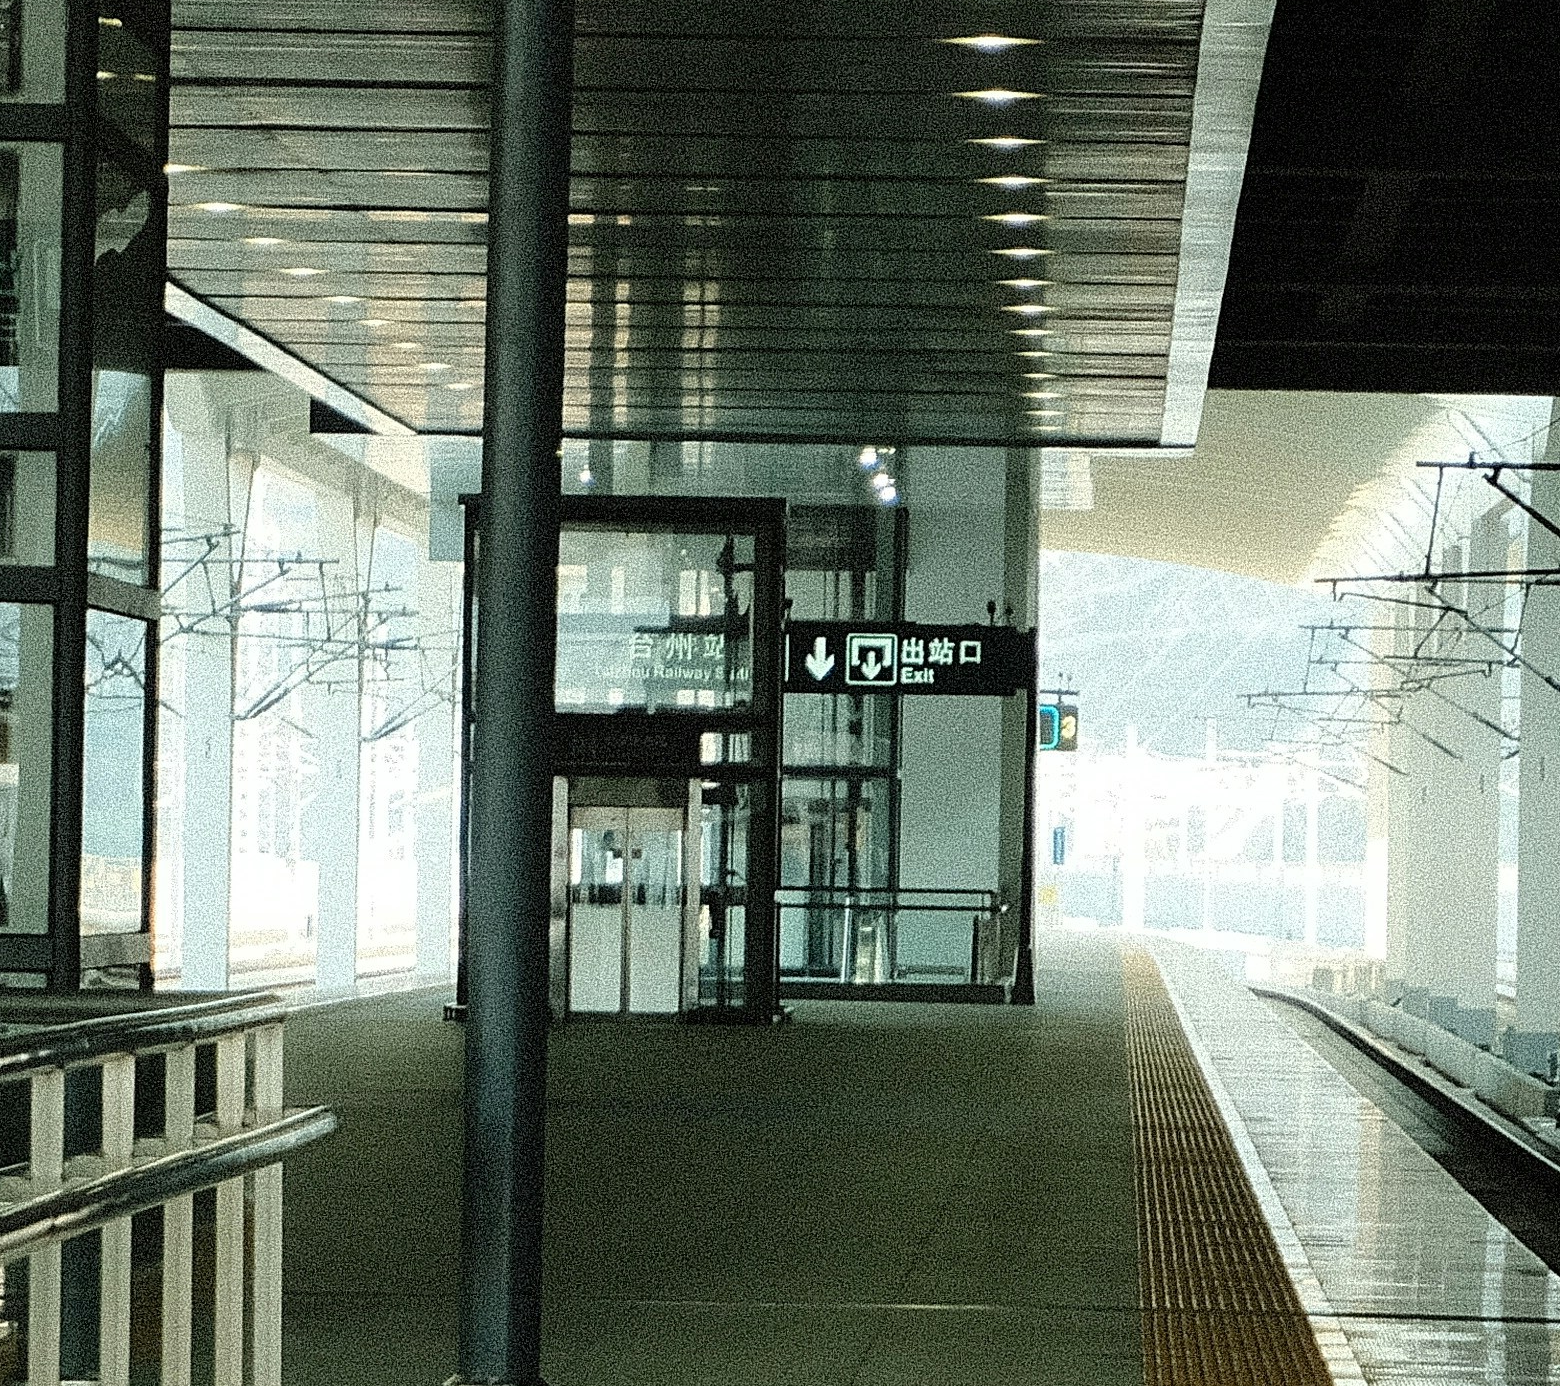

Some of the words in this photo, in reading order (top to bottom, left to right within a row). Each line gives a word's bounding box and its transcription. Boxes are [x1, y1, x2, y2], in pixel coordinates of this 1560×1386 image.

[900, 636, 983, 665] 出站口
[653, 665, 712, 682] Railway
[900, 666, 935, 685] Exit
